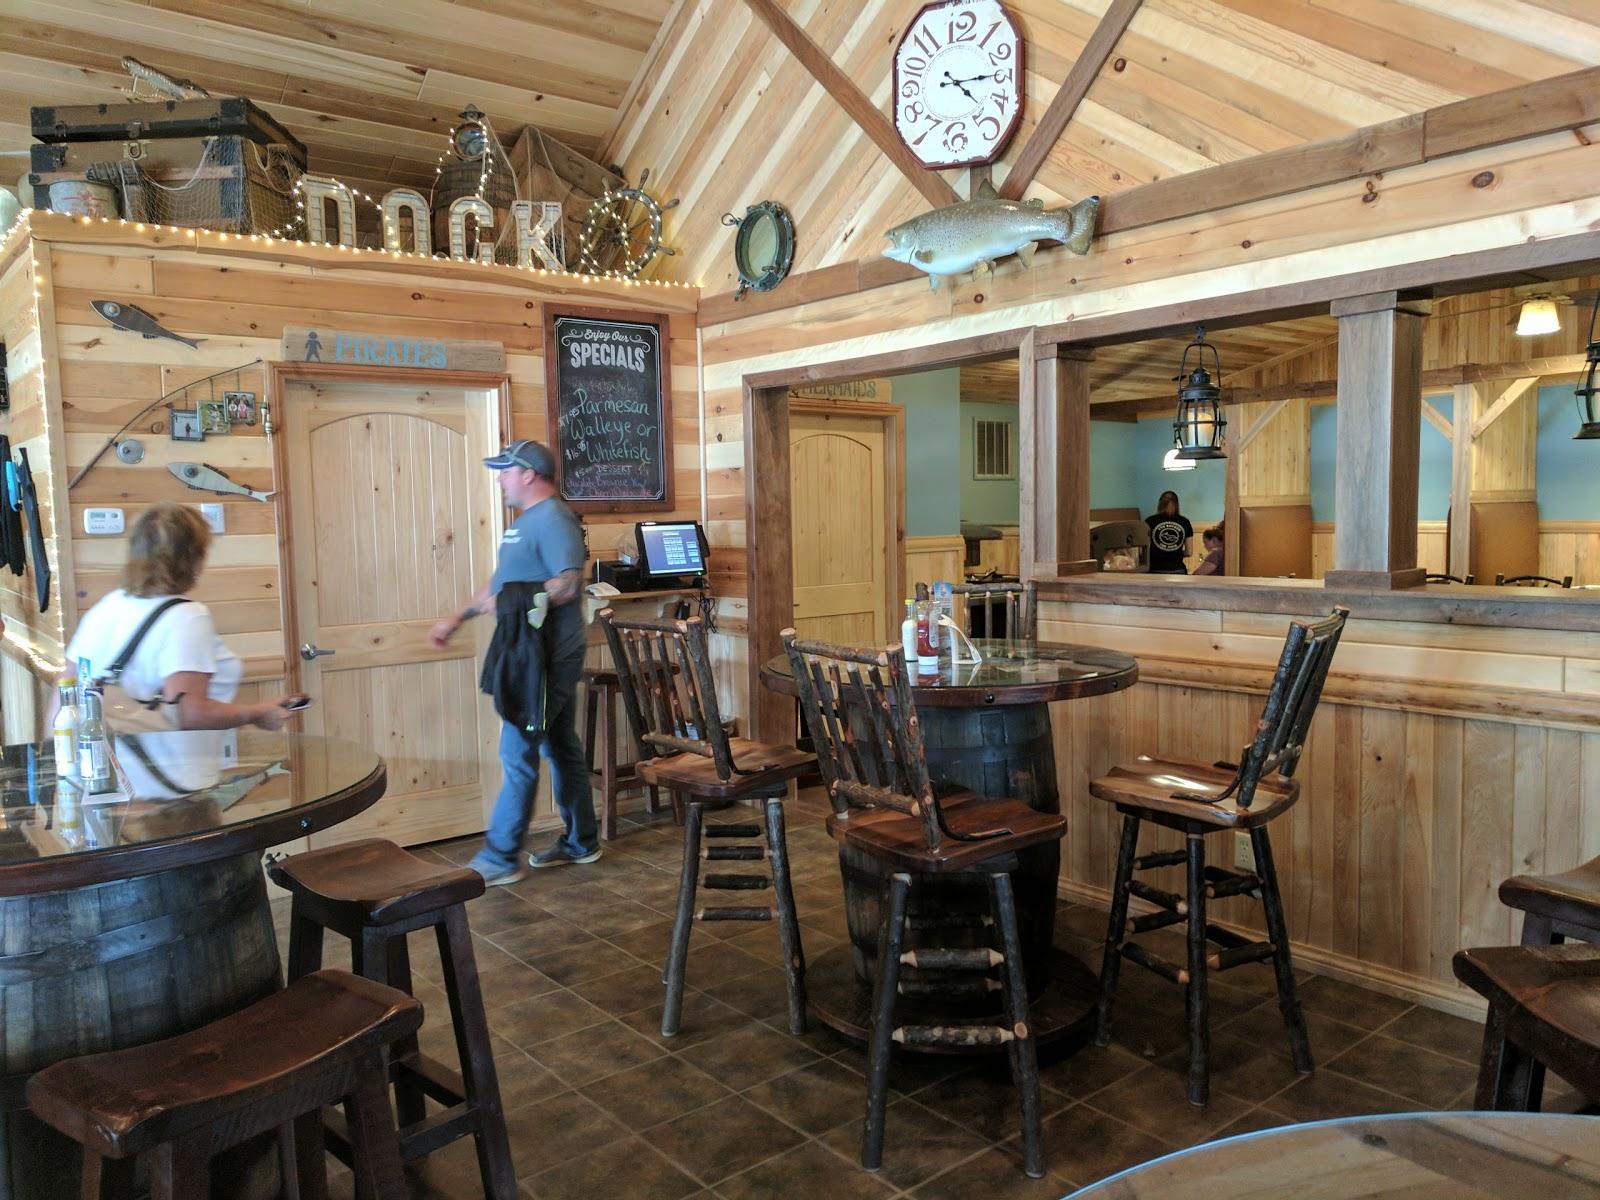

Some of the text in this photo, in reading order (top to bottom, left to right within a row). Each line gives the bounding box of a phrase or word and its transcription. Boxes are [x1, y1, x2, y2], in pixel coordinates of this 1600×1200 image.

[913, 24, 943, 59] 11
[947, 11, 977, 45] 12
[977, 21, 1002, 50] 1
[902, 57, 927, 79] 10
[988, 43, 1012, 67] 2
[902, 80, 920, 99] 9
[994, 68, 1013, 84] 3
[904, 101, 924, 124] 8
[990, 89, 1010, 116] 4
[912, 114, 944, 146] 7
[942, 122, 969, 153] 6
[972, 107, 1001, 141] 5
[301, 174, 567, 273] DOCK
[584, 329, 630, 343] Enjoy Our
[335, 335, 449, 369] PIRATES
[570, 342, 645, 373] SPECIALS
[573, 388, 650, 416] Parmesan
[571, 415, 657, 445] Walleye or
[586, 439, 652, 465] Whitefish
